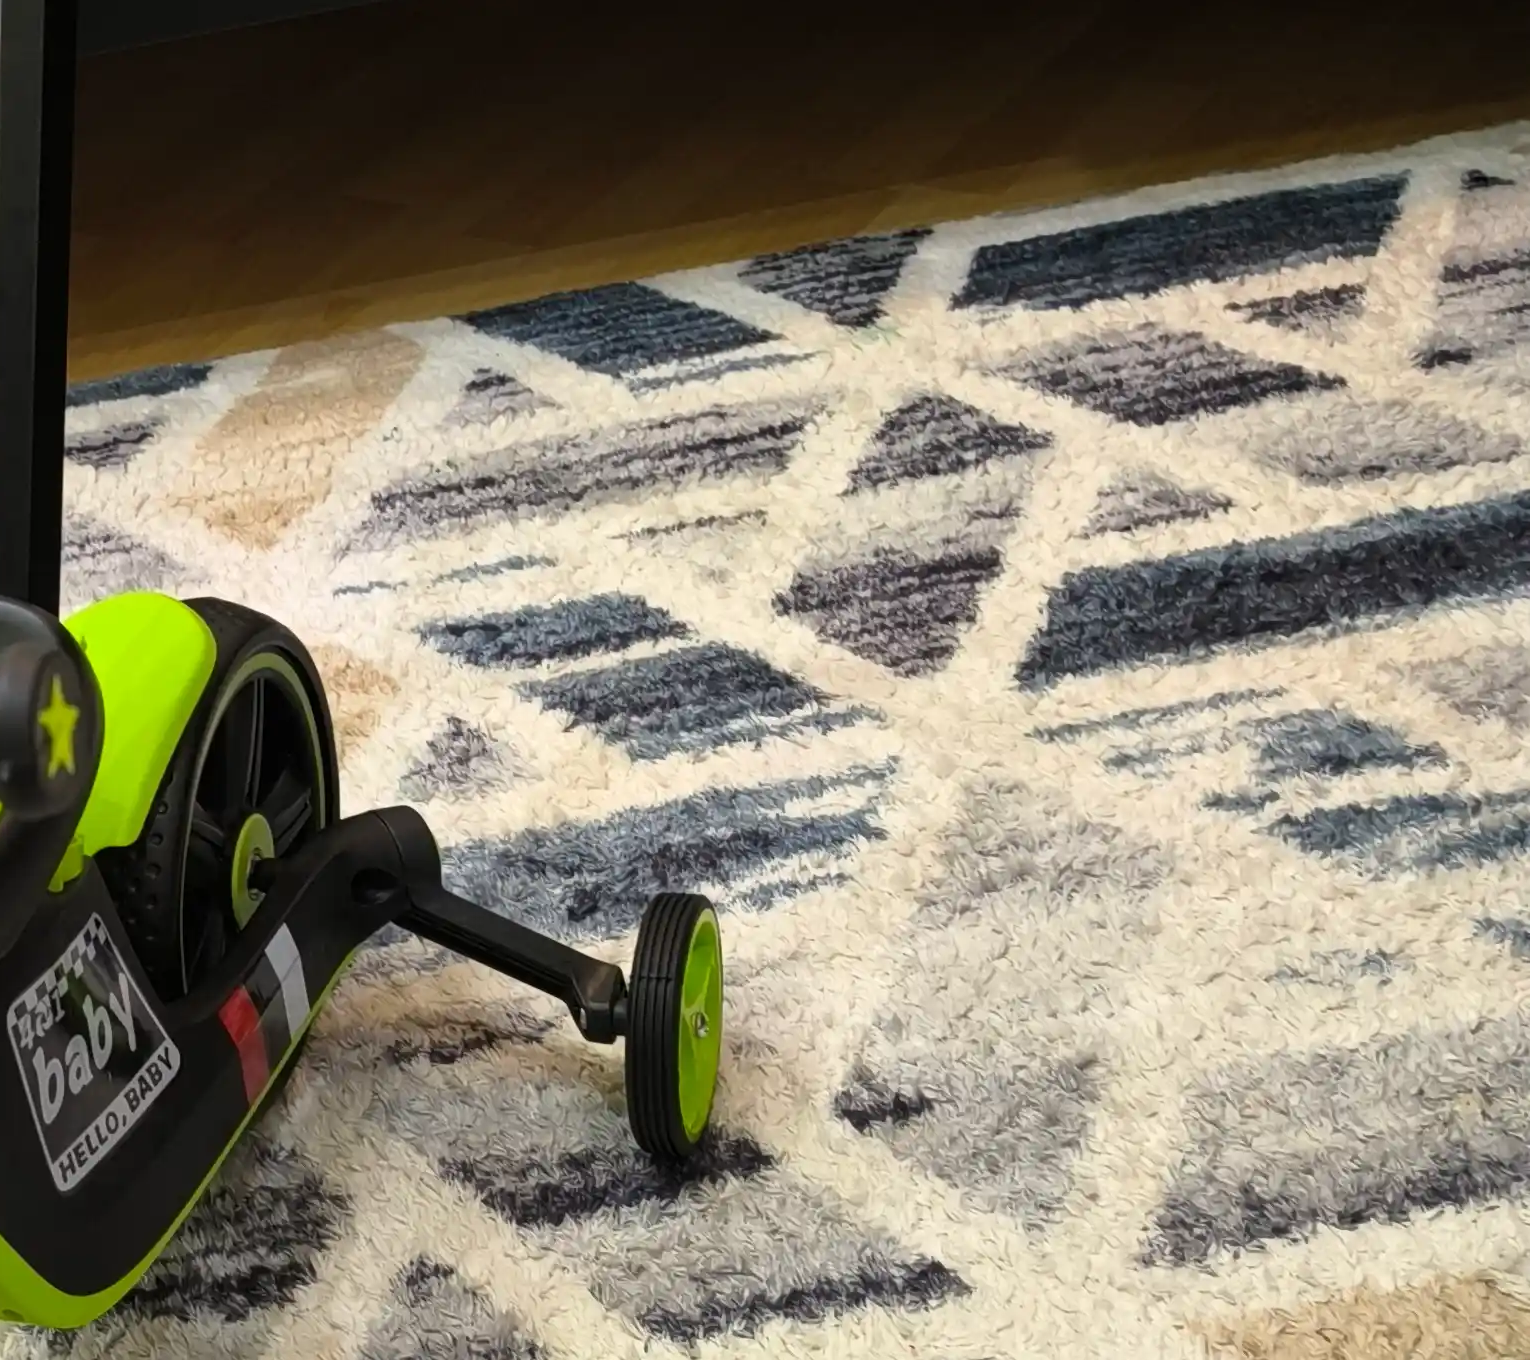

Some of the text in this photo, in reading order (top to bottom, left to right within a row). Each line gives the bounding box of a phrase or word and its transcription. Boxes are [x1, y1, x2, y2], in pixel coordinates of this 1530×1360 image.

[32, 972, 137, 1125] baby
[58, 1046, 174, 1183] HELLO, BABY
